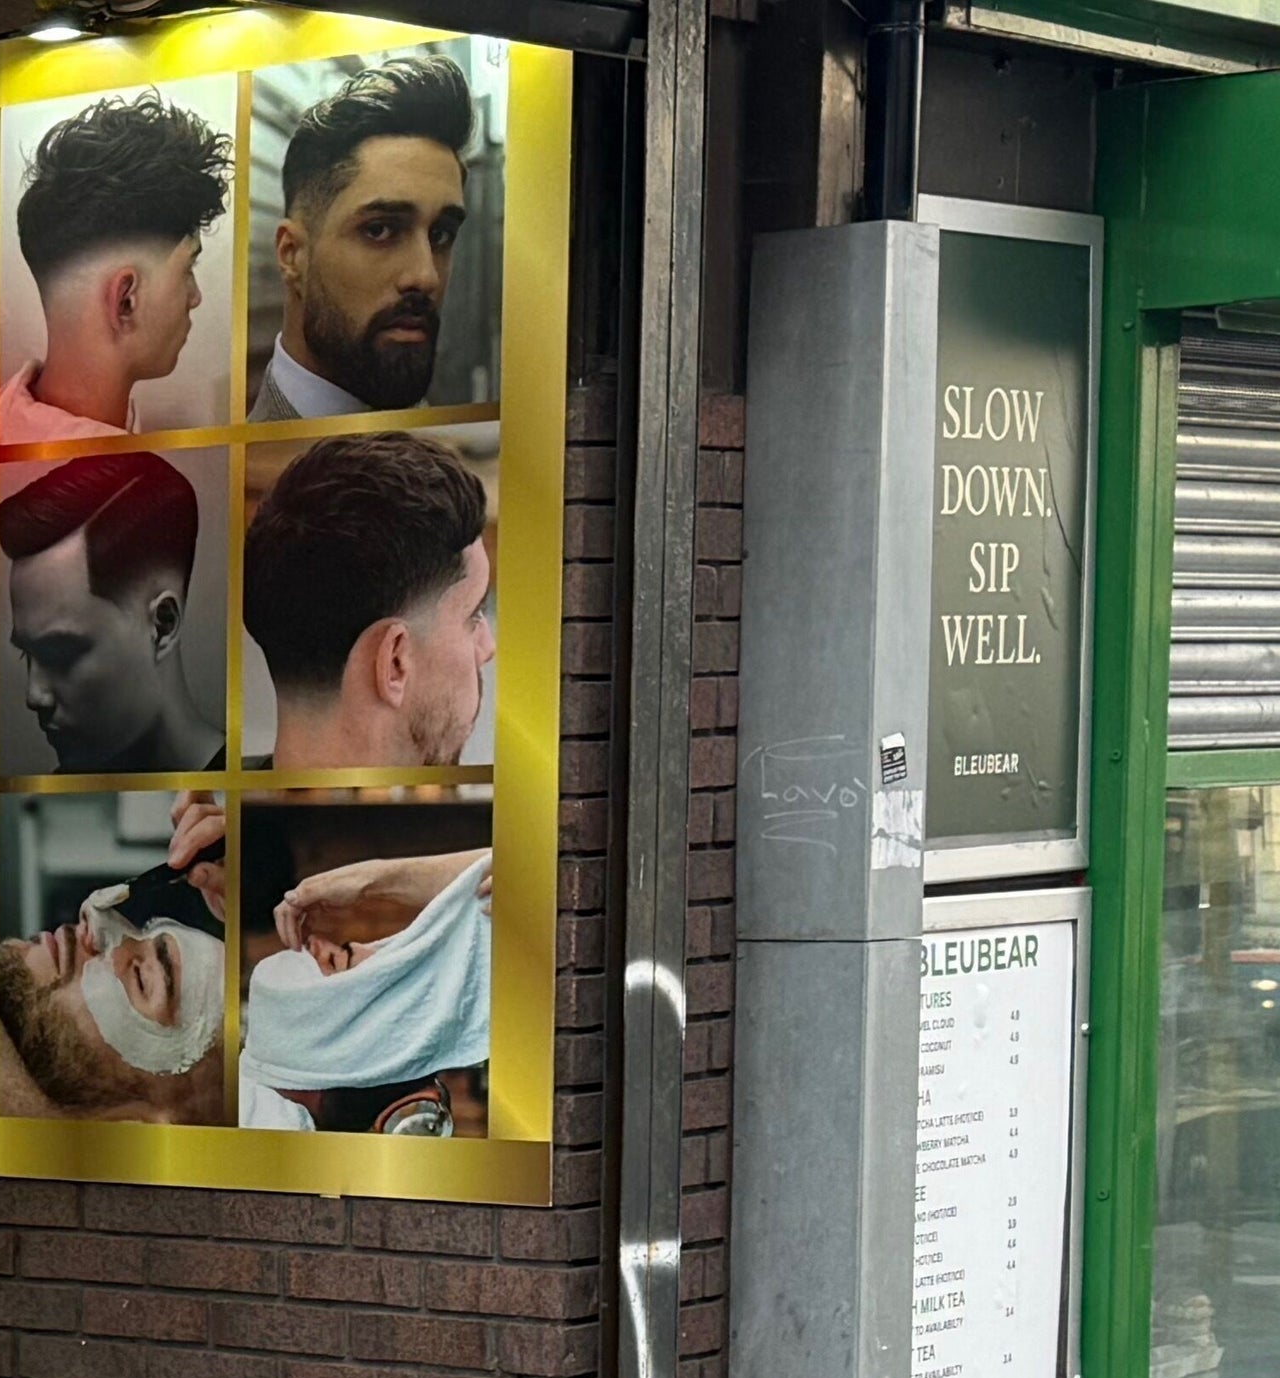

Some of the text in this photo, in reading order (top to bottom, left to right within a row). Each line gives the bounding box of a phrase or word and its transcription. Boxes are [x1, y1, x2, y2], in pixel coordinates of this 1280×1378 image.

[943, 385, 1044, 442] SLOW
[941, 464, 1052, 517] DOWN.
[969, 542, 1019, 593] SIP
[941, 614, 1041, 666] WELL.
[954, 753, 1019, 775] BLEUBEAR
[932, 1017, 955, 1030] CLOUD
[921, 1040, 952, 1053] COCONUT
[922, 1157, 959, 1173] CHOCOLATE
[921, 1295, 945, 1314] MILK
[947, 1290, 966, 1309] TEA
[915, 1325, 924, 1336] TO
[917, 1344, 936, 1362] TEA
